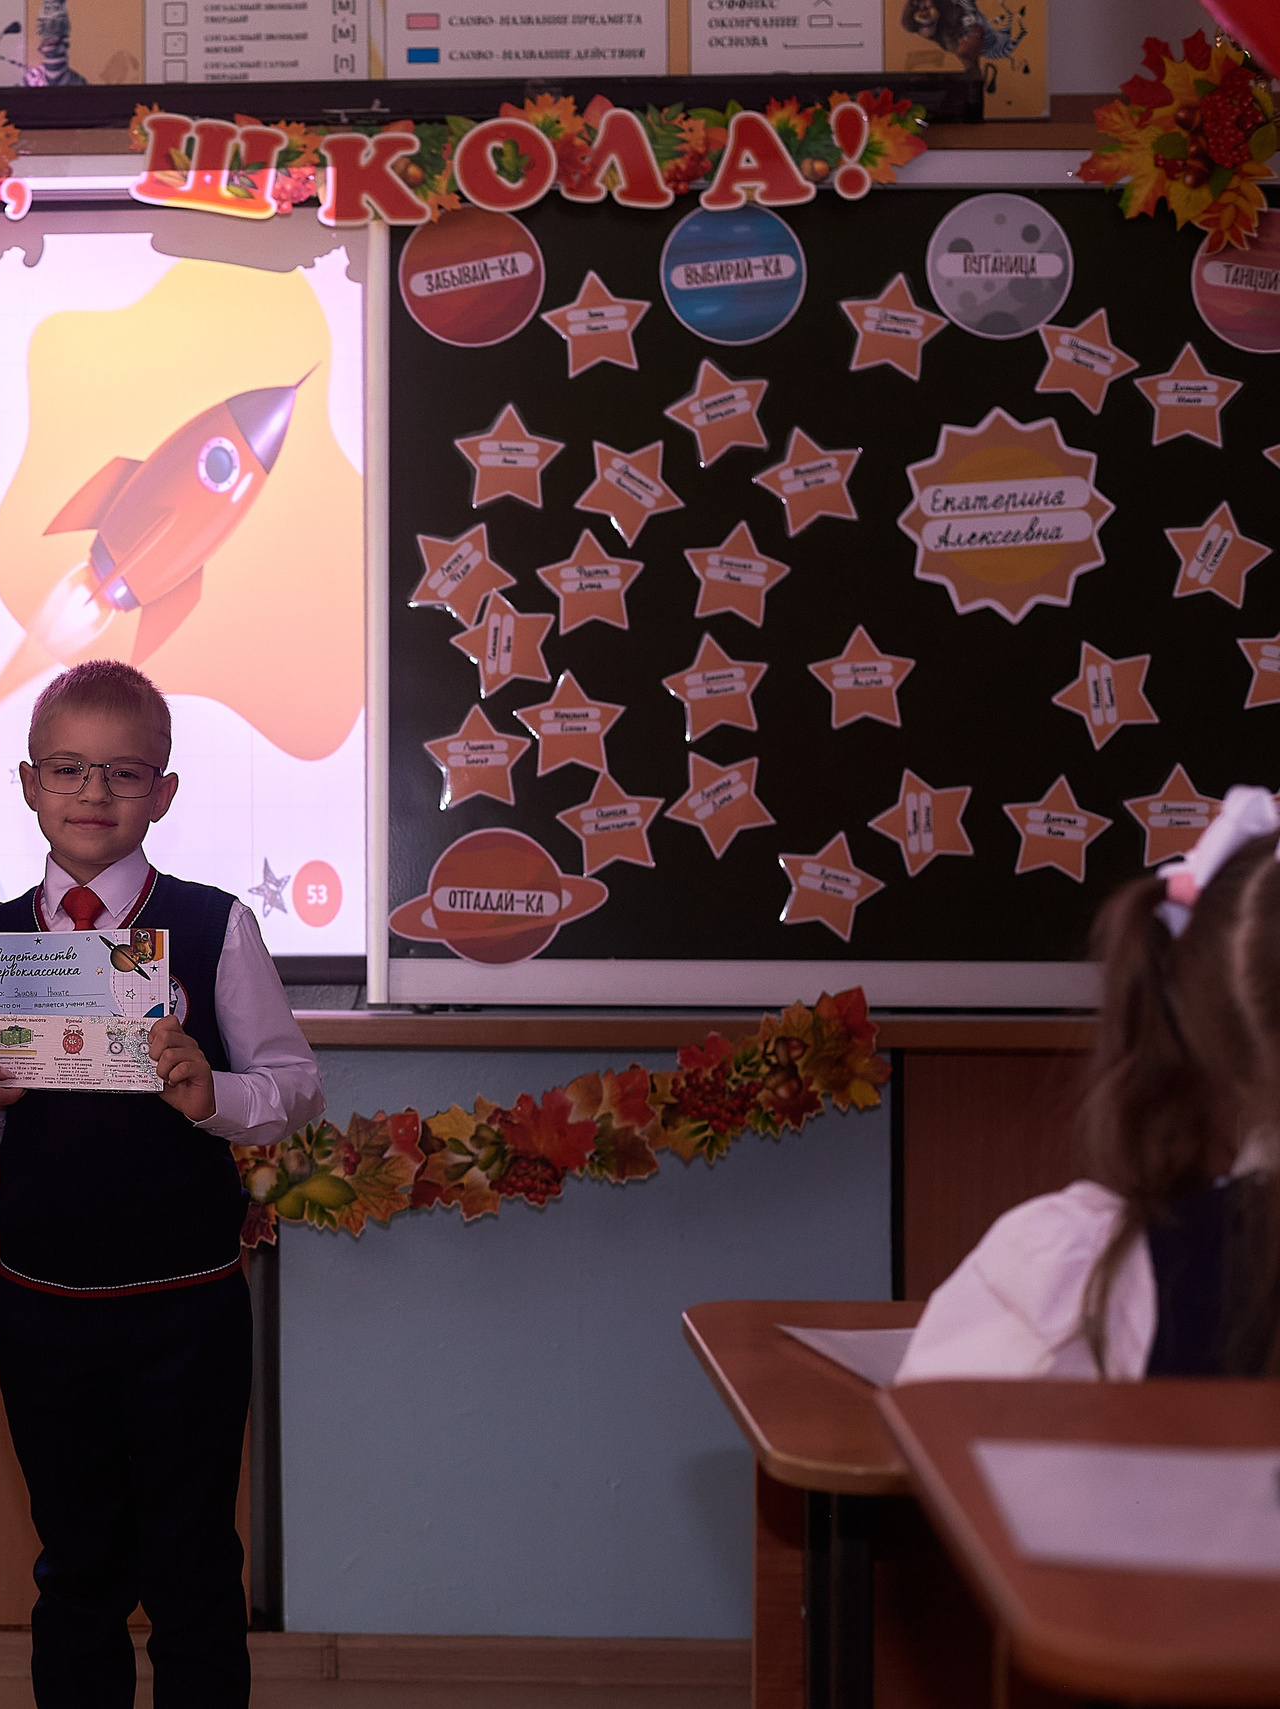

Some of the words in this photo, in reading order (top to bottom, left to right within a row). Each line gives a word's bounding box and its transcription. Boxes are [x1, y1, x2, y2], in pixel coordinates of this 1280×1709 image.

[131, 101, 873, 226] ШКОЛА!
[425, 254, 520, 294] ЗАБЫВАЙ-КА
[683, 258, 784, 287] ВЫБИРАЙ-КА
[963, 254, 1038, 277] ПУТАНИЦА
[931, 487, 1066, 514] Екатерина
[933, 515, 1064, 550] Алексеевна
[307, 884, 328, 905] 53
[448, 887, 545, 915] ОТГАДАЙ-КА
